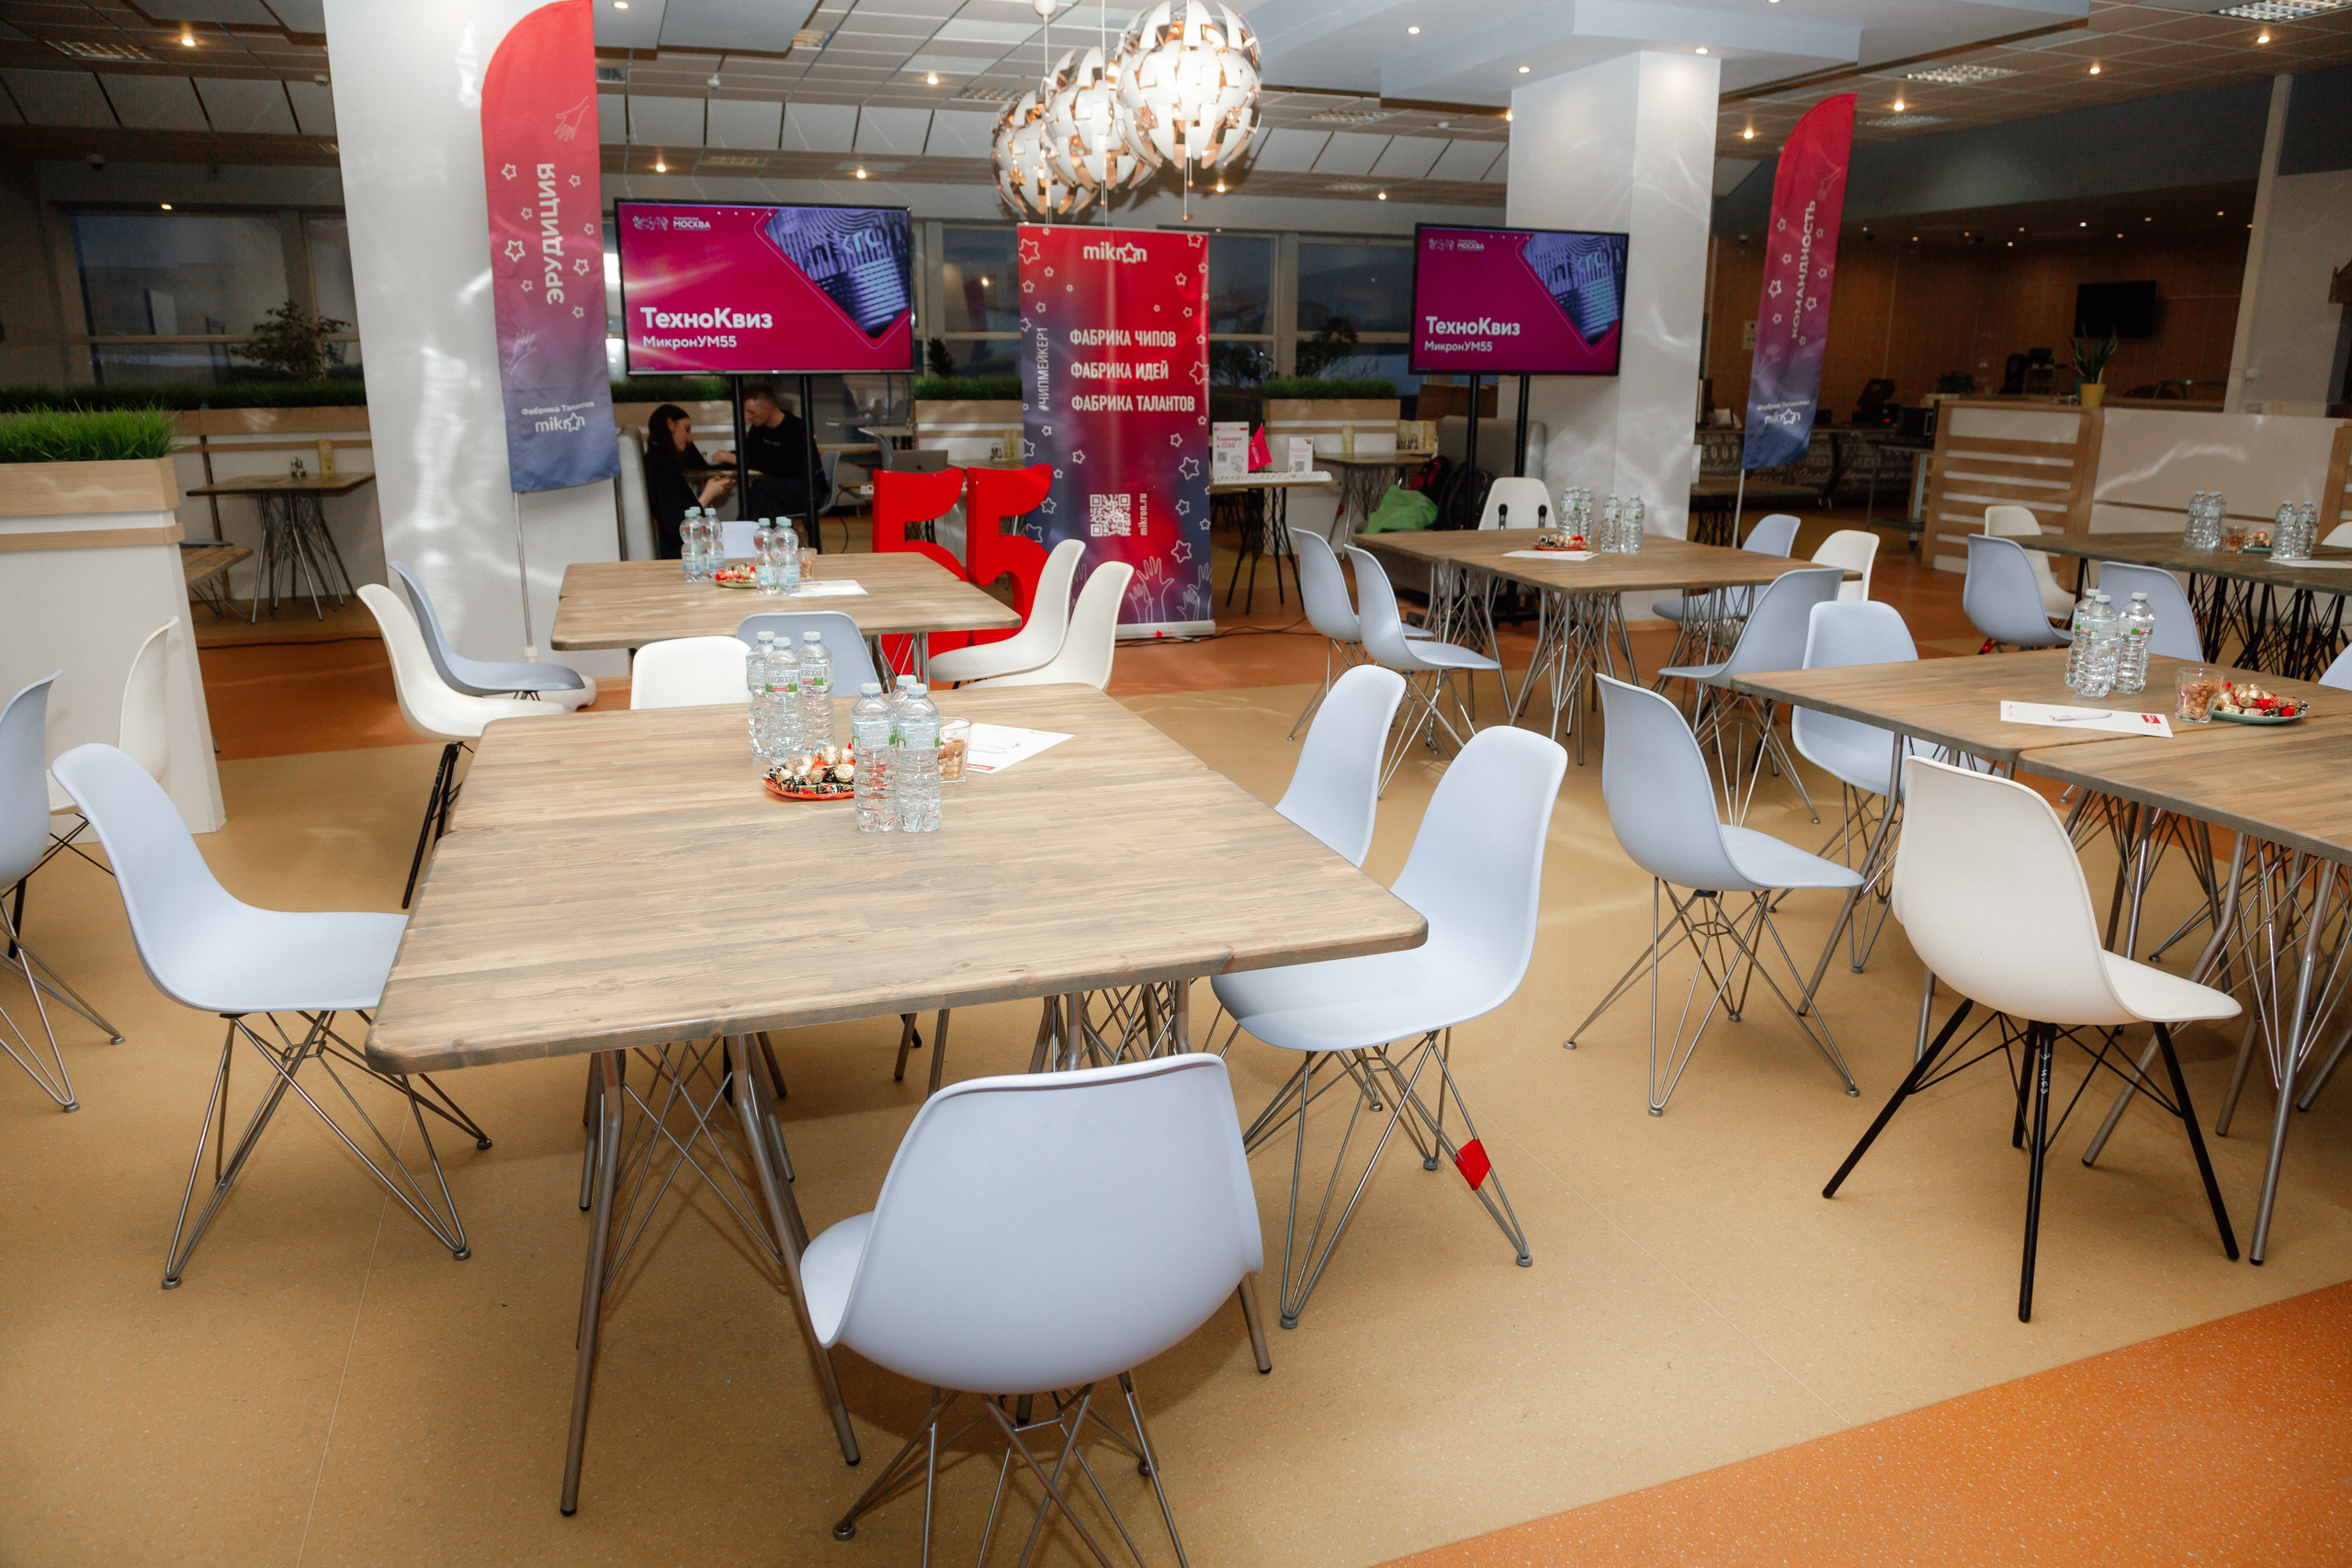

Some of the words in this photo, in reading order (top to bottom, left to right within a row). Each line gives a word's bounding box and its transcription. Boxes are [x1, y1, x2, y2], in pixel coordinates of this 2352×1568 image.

[537, 163, 565, 305] ЭРУДИЦИЯ
[673, 220, 711, 229] МОСКВА
[1791, 199, 1816, 340] КОМАНДНОСТЬ
[639, 306, 774, 329] ТехноКвиз
[1425, 315, 1521, 337] ТехноКвиз
[642, 335, 738, 349] МикронУМ55
[1069, 328, 1132, 347] ФАБРИКА
[1134, 330, 1177, 348] ЧИПОВ
[1424, 340, 1494, 353] МикронУМ55
[1036, 327, 1050, 412] #ЧИПМЕЙКЕР1
[1070, 361, 1133, 379] ФАБРИКА
[1136, 359, 1170, 380] ИДЕЙ
[520, 407, 560, 416] Фабрика
[561, 401, 595, 412] Талантов
[1070, 394, 1134, 412] ФАБРИКА
[1136, 395, 1196, 412] ТАЛАНТОВ
[1137, 492, 1148, 536] mikron.ru
